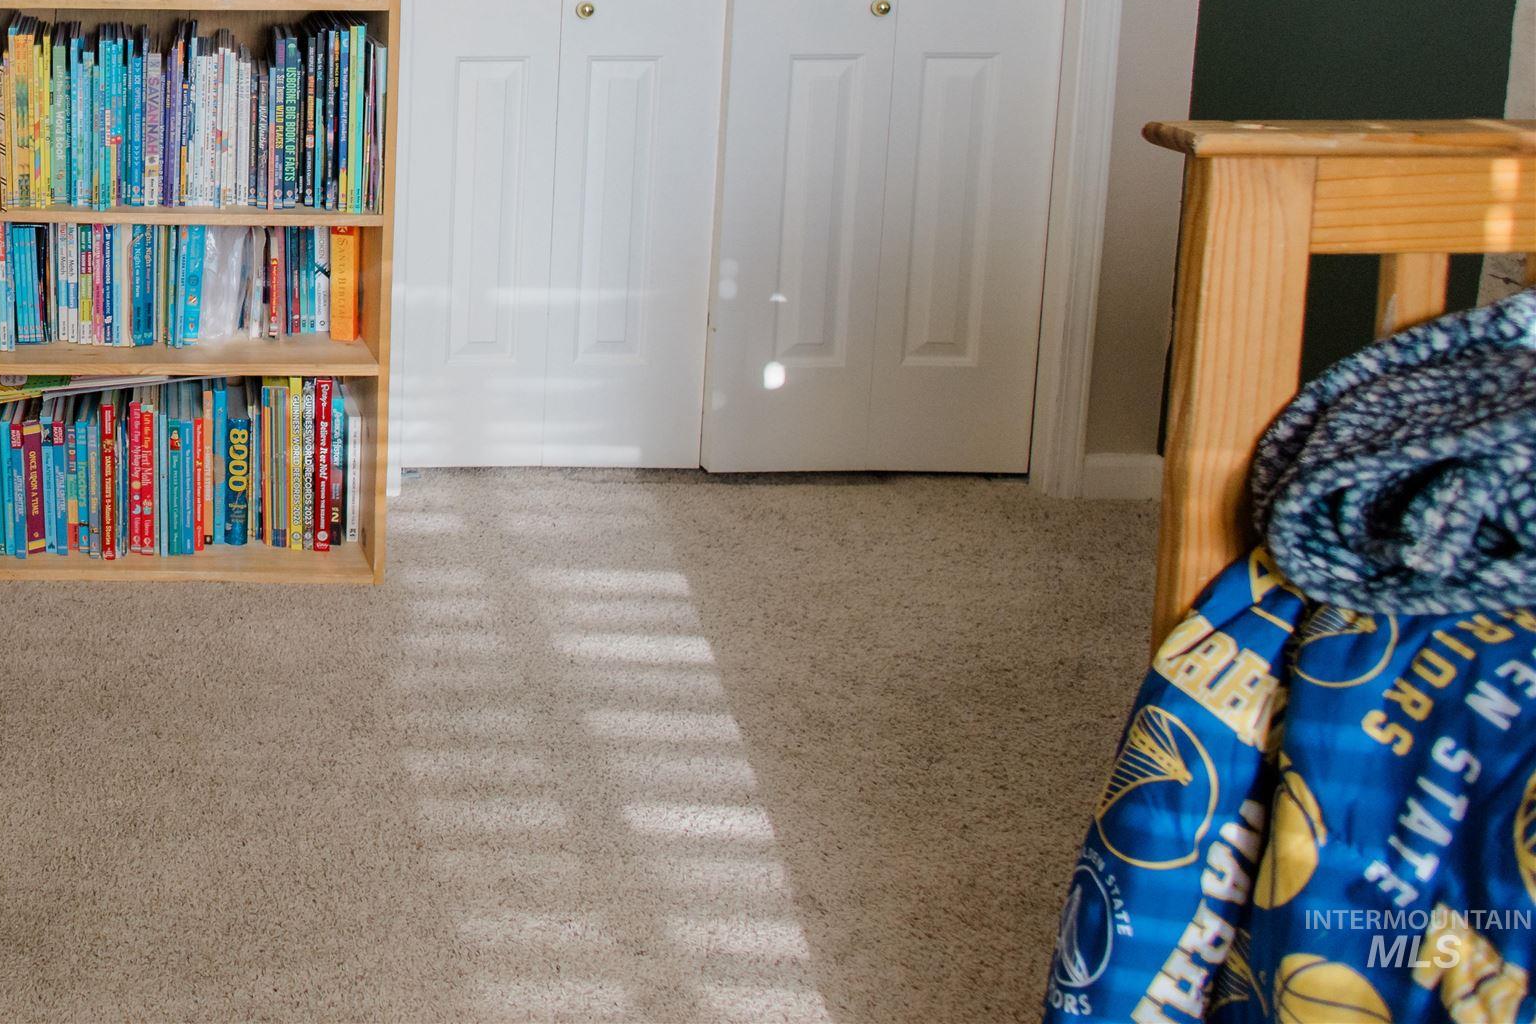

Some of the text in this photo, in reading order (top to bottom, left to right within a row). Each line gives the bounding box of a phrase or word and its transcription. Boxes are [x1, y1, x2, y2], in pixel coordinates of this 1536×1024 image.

[276, 75, 284, 85] SEE
[56, 111, 65, 134] Word
[147, 77, 160, 154] SAVANNAH
[275, 105, 283, 123] WILD
[285, 67, 297, 181] USBORNE BIG BOOK OF FACTS
[275, 125, 283, 149] PLACES
[338, 238, 348, 318] SANTA BIBLIA
[292, 395, 300, 435] GUINNESS
[304, 394, 313, 435] GUINNESS
[320, 421, 329, 446] Believe
[29, 451, 37, 470] ONCE
[142, 450, 151, 467] First
[228, 428, 248, 492] 8000
[292, 437, 300, 467] WORLD
[304, 437, 312, 466] WORLD
[29, 471, 38, 490] UPON
[78, 460, 87, 507] Tractors
[142, 468, 151, 486] Math
[319, 462, 328, 480] Not!
[292, 467, 301, 505] RECORDS
[304, 467, 312, 505] RECORDS
[31, 497, 39, 516] TIME
[1364, 736, 1482, 908] STATE
[1104, 873, 1135, 938] STATE
